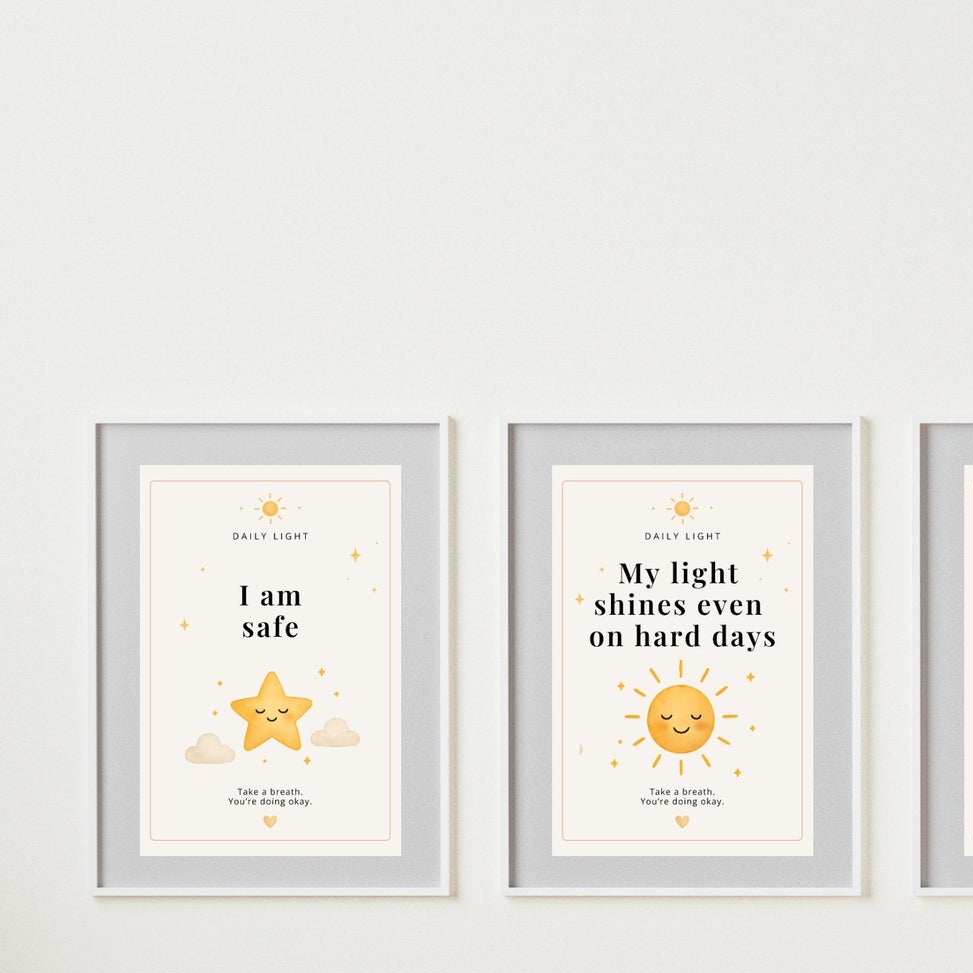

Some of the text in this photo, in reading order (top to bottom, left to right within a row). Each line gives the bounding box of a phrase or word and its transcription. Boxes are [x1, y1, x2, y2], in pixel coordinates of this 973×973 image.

[232, 532, 309, 541] DAILY LIGHT
[644, 532, 721, 541] DAILY LIGHT
[618, 560, 739, 590] My light
[239, 585, 302, 607] I am
[594, 592, 763, 617] shines even
[242, 614, 299, 639] safe
[589, 623, 777, 653] on hard days
[237, 787, 259, 796] Take
[270, 787, 303, 796] breath.
[649, 787, 671, 796] Take
[682, 787, 715, 796] breath.
[259, 797, 286, 807] doing
[288, 797, 313, 807] okay.
[671, 797, 698, 807] doing
[700, 797, 725, 807] okay.
